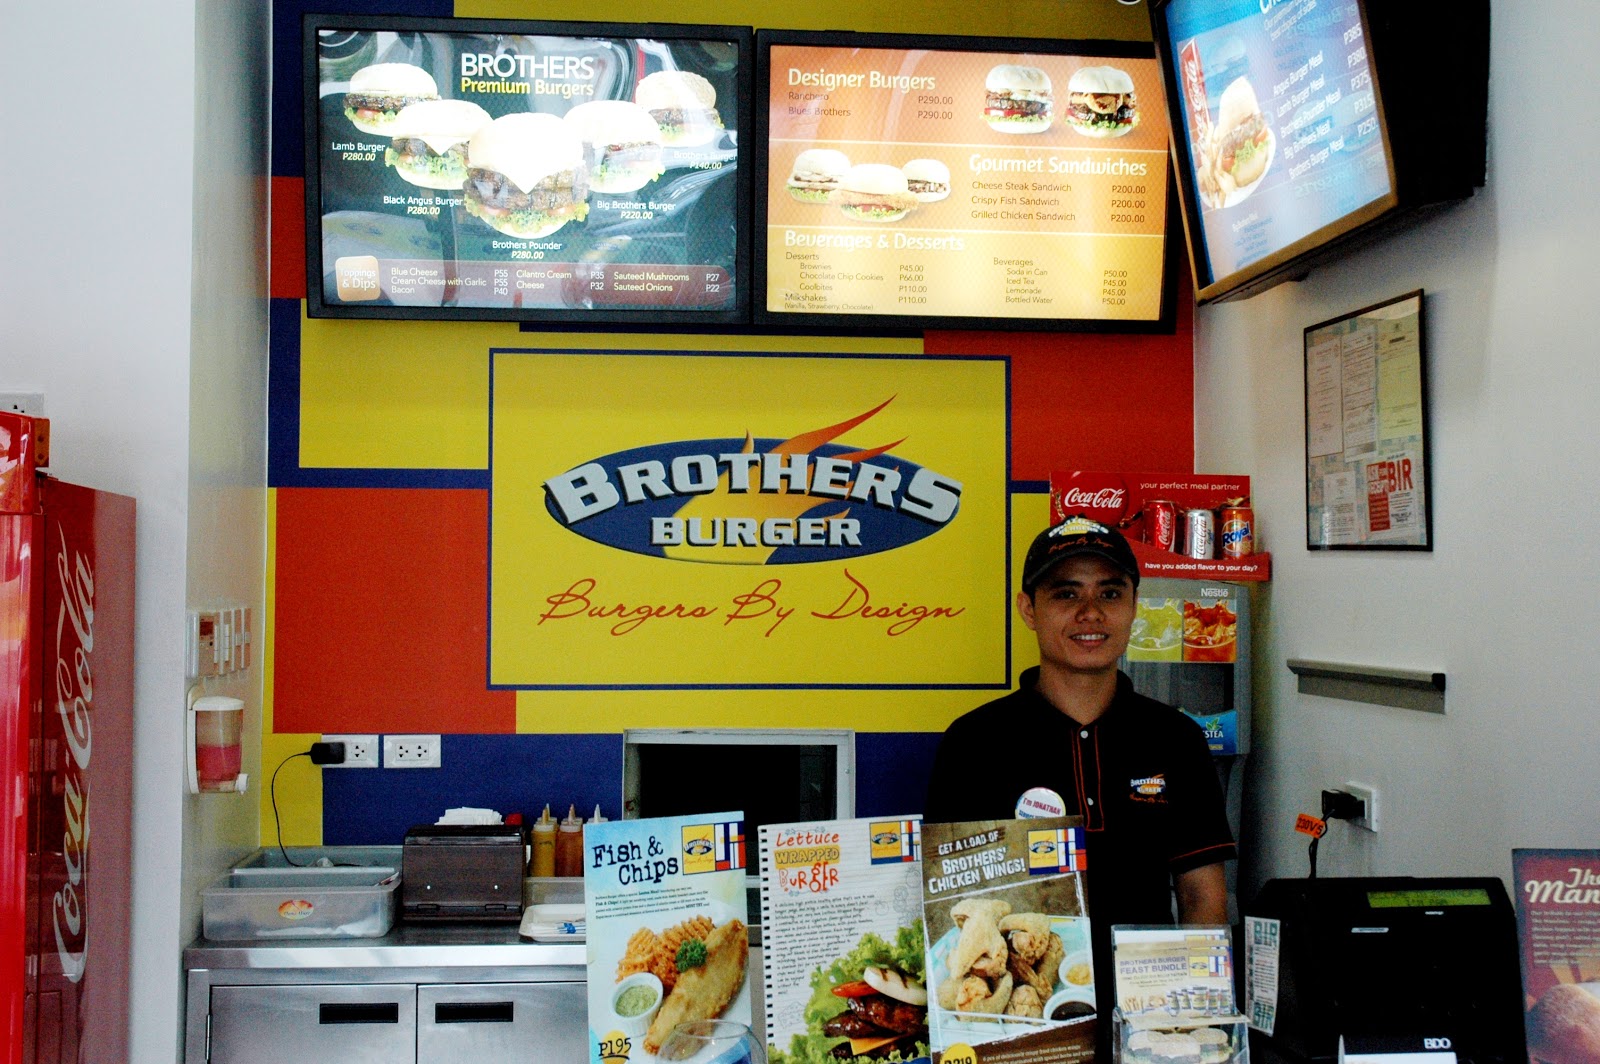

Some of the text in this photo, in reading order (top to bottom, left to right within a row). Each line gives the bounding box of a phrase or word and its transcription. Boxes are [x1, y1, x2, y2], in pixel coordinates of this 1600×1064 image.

[461, 52, 594, 80] BROTHERS
[1308, 50, 1323, 70] Meal
[460, 76, 594, 98] Premium Burgers
[788, 68, 936, 94] Designer Burgers
[1310, 73, 1325, 94] Meal
[788, 92, 953, 105] Ranchero P290.00
[1325, 87, 1341, 107] Meal
[814, 107, 851, 117] Brothers
[917, 111, 953, 119] P290.00
[1316, 119, 1330, 138] Meal
[332, 142, 385, 153] Lamb Burger
[1329, 135, 1345, 154] Meal
[343, 153, 376, 161] P280.00
[969, 154, 1147, 176] Gourmet Sandwiches
[972, 181, 1146, 194] Cheese Steak Sandwich P200.00
[383, 196, 463, 207] Black Angus Burger
[597, 201, 676, 211] Big Brothers Burger
[971, 196, 1145, 209] Crispy Fish Sandwich P200.00
[407, 207, 440, 215] P280.00
[620, 211, 653, 219] P220.00
[971, 211, 1145, 223] Grilled Chicken Sandwich P200.00
[492, 241, 562, 250] Brothers Pounder
[784, 230, 965, 252] Beverages & Desserts
[511, 251, 544, 260] P280.00
[785, 252, 820, 261] Desserts
[800, 263, 924, 273] Brownies P45.00
[993, 257, 1034, 267] Beverages
[341, 268, 376, 279] Toppings
[391, 268, 408, 276] Blue
[409, 268, 438, 276] Cheese
[516, 270, 546, 279] Cilantro
[547, 271, 572, 279] Cream
[614, 272, 644, 280] Sauteed
[646, 272, 690, 281] Mushrooms
[800, 272, 924, 282] Chocolate Chip Cookies P66.00
[1006, 268, 1025, 276] Soda
[1026, 268, 1033, 276] in
[1104, 270, 1128, 278] P50.00
[342, 279, 376, 291] & Dips
[391, 277, 416, 285] Cream
[417, 277, 446, 285] Cheese
[447, 278, 463, 286] with
[465, 278, 487, 286] Garlic
[516, 281, 545, 289] Cheese
[614, 283, 645, 291] Sauteed
[647, 283, 673, 292] Onions
[1103, 279, 1127, 287] P45.00
[391, 286, 415, 294] Bacon
[799, 283, 928, 293] Coolbites P110.00
[784, 293, 927, 304] Milkshakes P110.00
[1387, 458, 1414, 493] BIR
[540, 453, 963, 525] BROTHERS
[1140, 481, 1240, 492] your perfect meal partner
[1064, 487, 1126, 509] Coca-Cola
[651, 516, 862, 547] BURGER
[1242, 564, 1258, 572] day?
[538, 567, 965, 638] Burgers By Design
[776, 831, 840, 847] Lettuce
[938, 831, 1000, 856] GET A LOAD OF
[592, 835, 664, 869] Fish &
[775, 848, 840, 865] WRAPPED
[618, 857, 679, 886] Chips
[928, 857, 1026, 895] CHICKEN WINGS!
[1120, 963, 1188, 975] FEAST BUNDLE
[598, 1037, 632, 1057] P195
[1423, 1037, 1451, 1049] BDO
